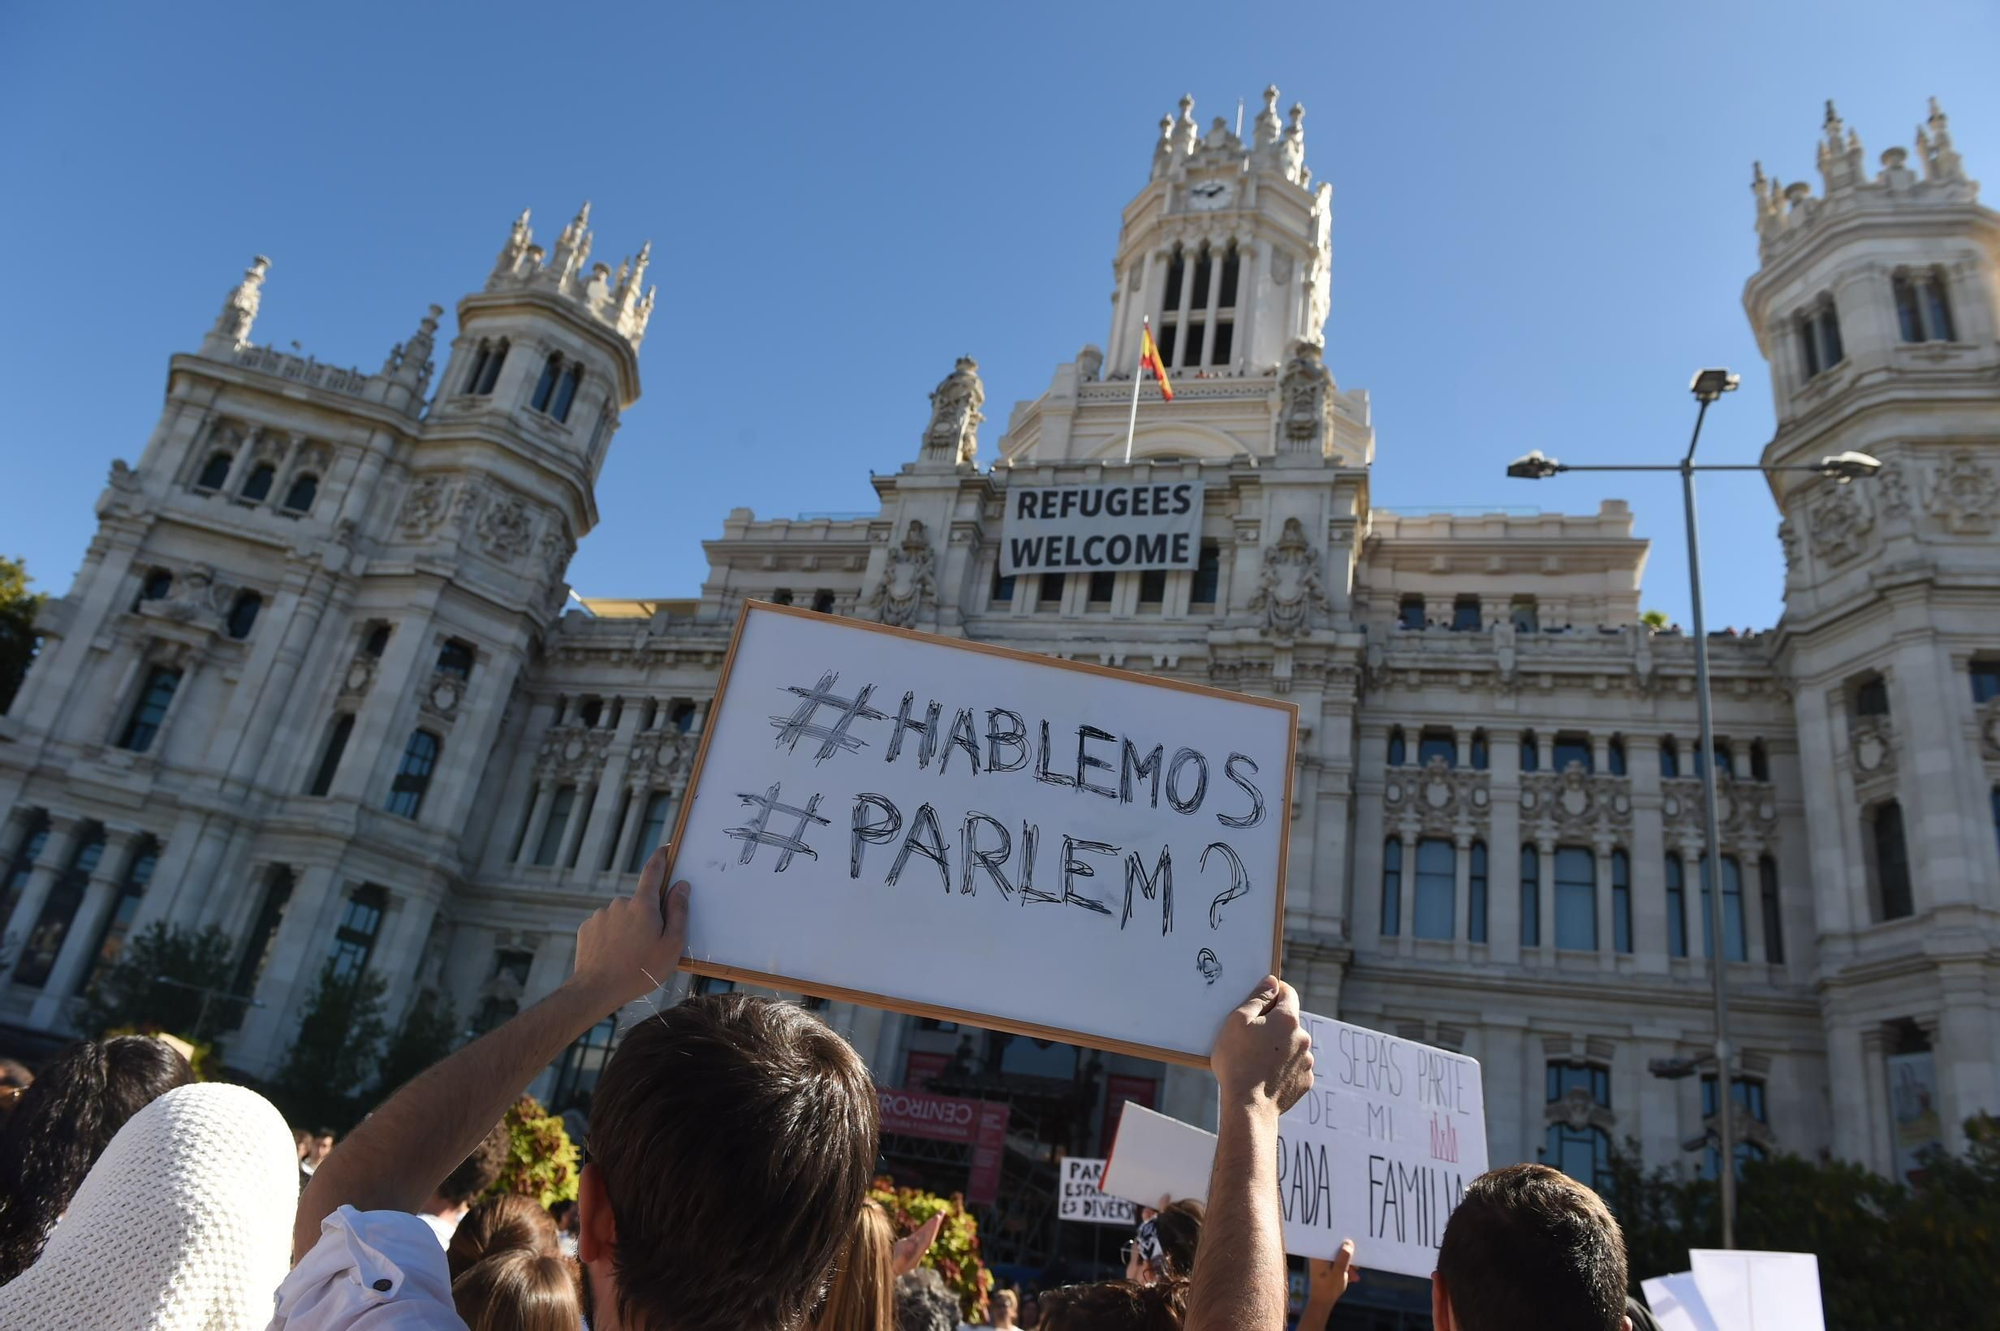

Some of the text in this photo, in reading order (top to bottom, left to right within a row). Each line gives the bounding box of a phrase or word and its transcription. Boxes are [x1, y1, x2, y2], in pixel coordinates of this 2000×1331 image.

[1017, 484, 1191, 520] REFUGEES
[1011, 532, 1190, 568] WELCOME
[769, 670, 1266, 829] #HABLEMOS
[1417, 1049, 1470, 1115] PARTE
[1308, 1091, 1393, 1143] DE MI
[1070, 1162, 1102, 1180] PAR
[1278, 1136, 1332, 1229] RADA
